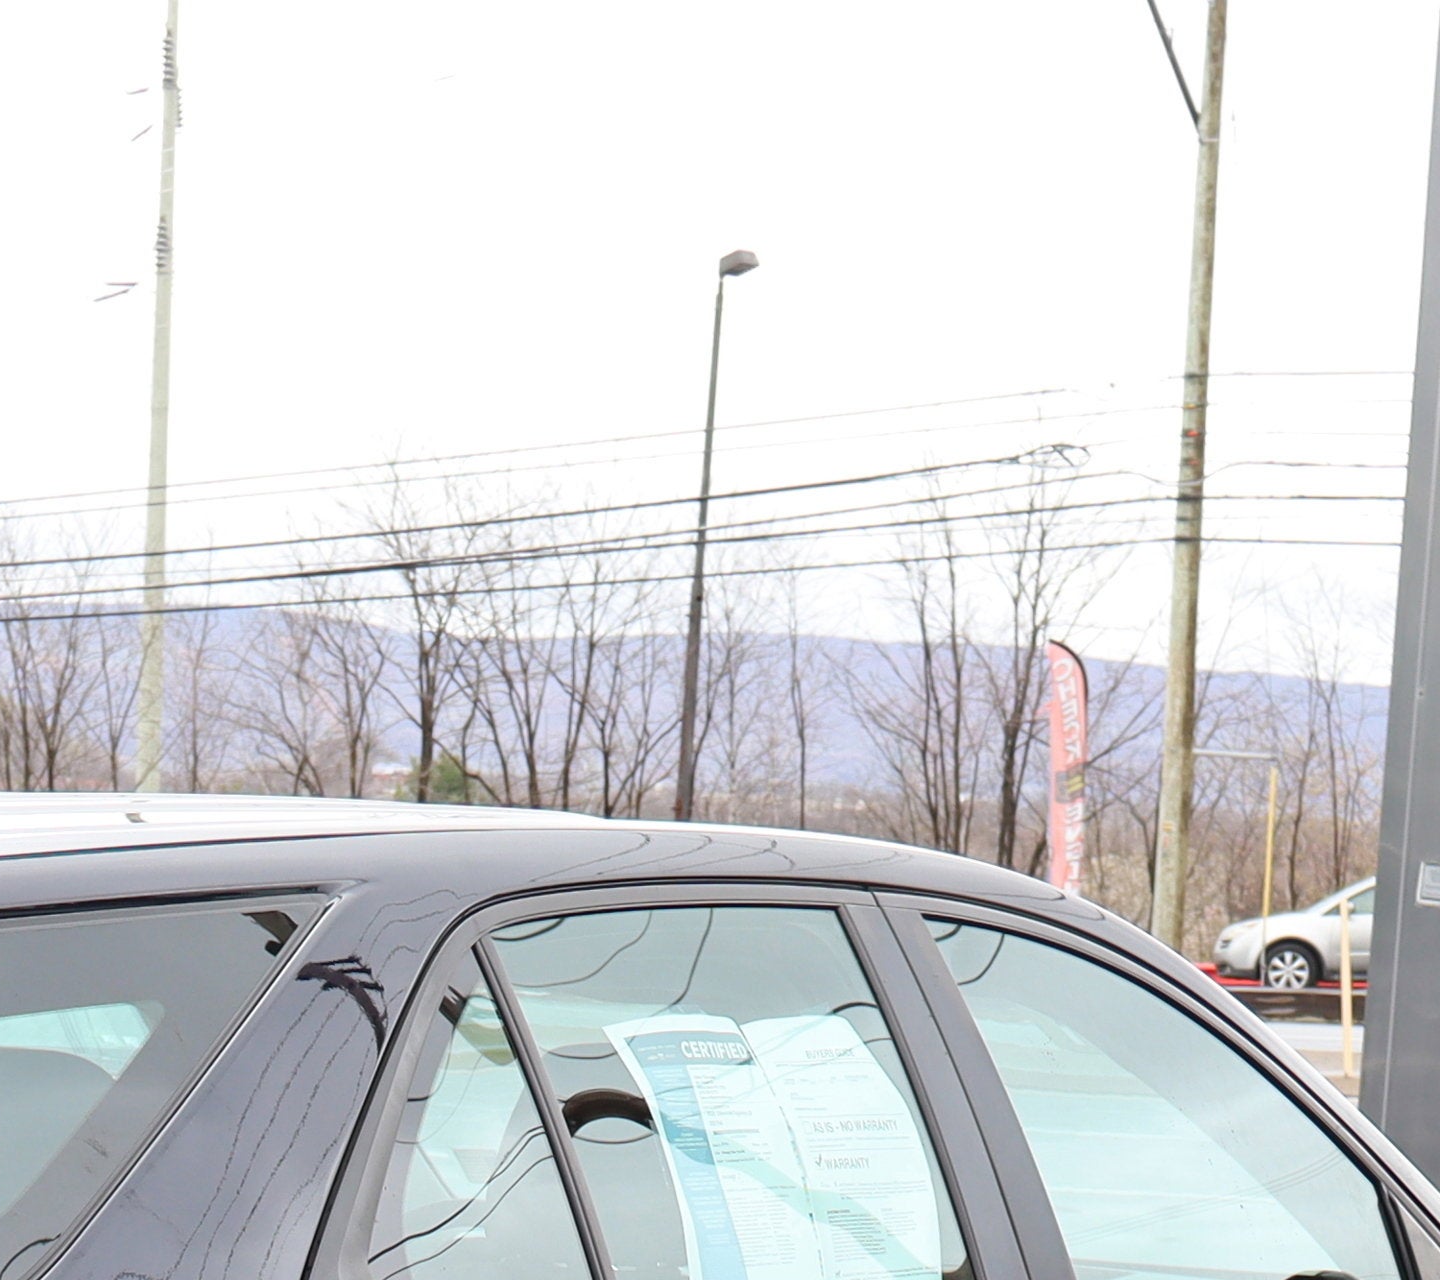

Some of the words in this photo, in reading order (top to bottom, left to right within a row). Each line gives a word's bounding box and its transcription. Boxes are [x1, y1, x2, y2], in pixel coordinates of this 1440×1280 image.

[680, 1040, 748, 1060] CERTIFIED
[840, 1120, 854, 1132] NO
[856, 1119, 898, 1131] WARRANTY
[824, 1157, 870, 1170] WARRANTY
